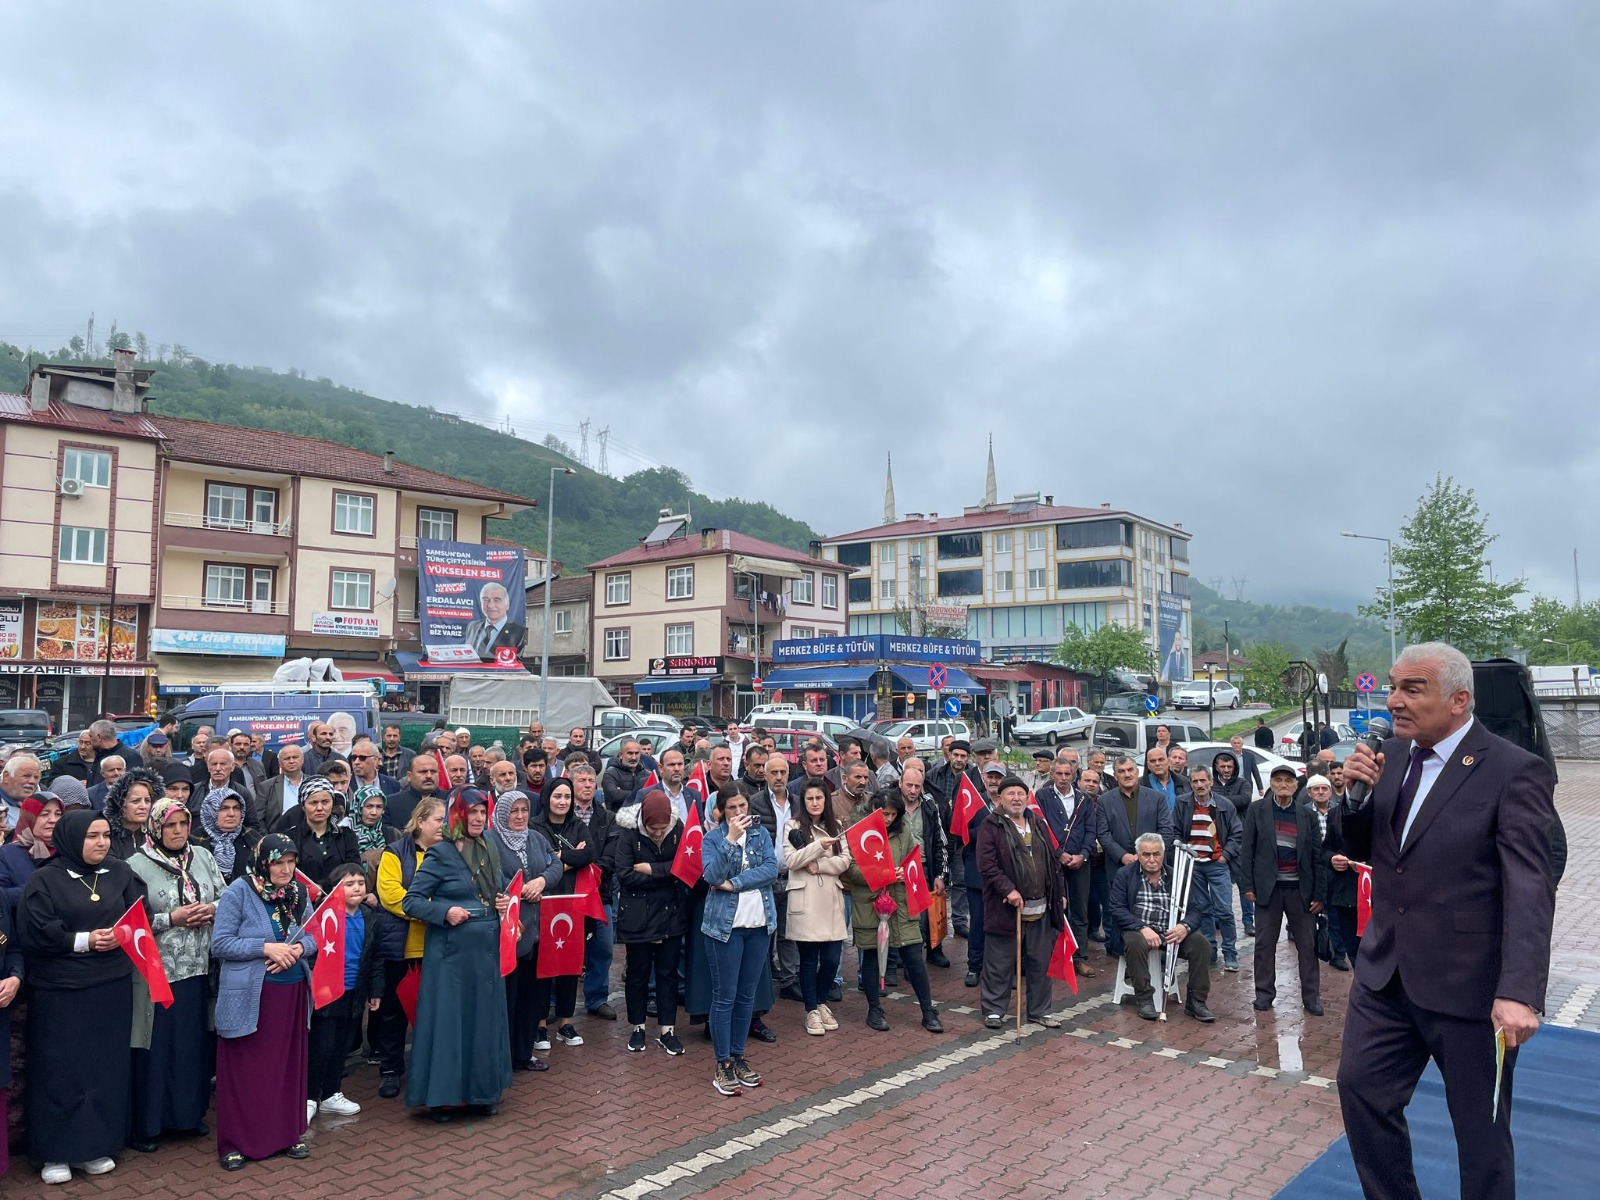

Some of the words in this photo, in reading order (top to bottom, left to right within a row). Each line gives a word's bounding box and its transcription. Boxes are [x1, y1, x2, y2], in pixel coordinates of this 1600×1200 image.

[426, 549, 471, 558] SAMSUN'DAN
[426, 555, 446, 563] TÜRK
[446, 557, 486, 567] ÇİFTÇİSİNİN
[428, 565, 478, 577] YÜKSELEN
[480, 569, 500, 579] SESİ
[426, 596, 455, 605] ERDAL
[456, 598, 474, 606] AVCI
[343, 617, 363, 625] FOTO
[778, 645, 811, 656] MERKEZ
[813, 643, 835, 654] BÜFE
[837, 645, 844, 653] &
[845, 641, 875, 653] TÜTÜN
[889, 642, 921, 653] MERKEZ
[923, 643, 943, 654] BÜFE
[945, 646, 950, 654] &
[952, 646, 976, 656] TÜTÜN
